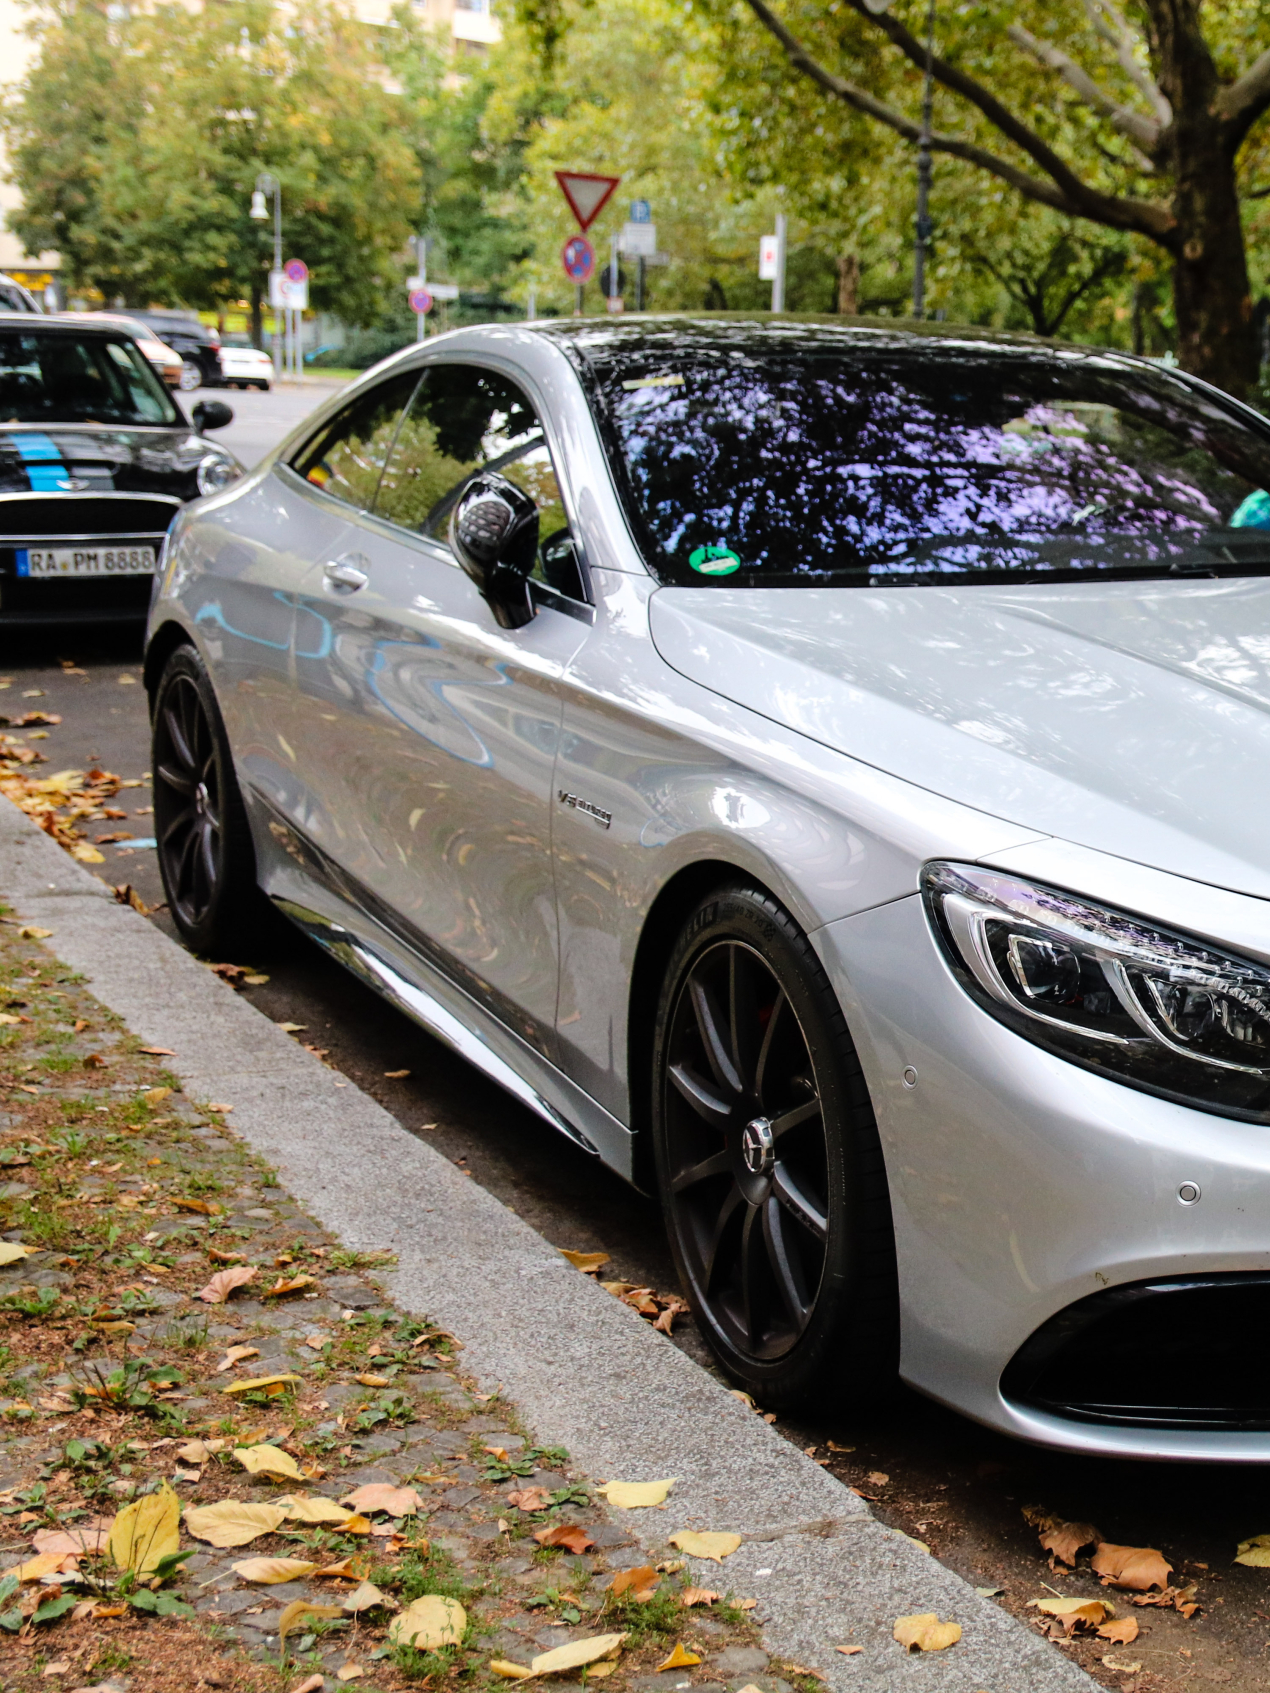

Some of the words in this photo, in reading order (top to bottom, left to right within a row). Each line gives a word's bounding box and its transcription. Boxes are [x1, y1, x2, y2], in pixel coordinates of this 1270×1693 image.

[31, 553, 58, 571] RA
[73, 552, 99, 571] PM
[104, 551, 151, 570] 8888
